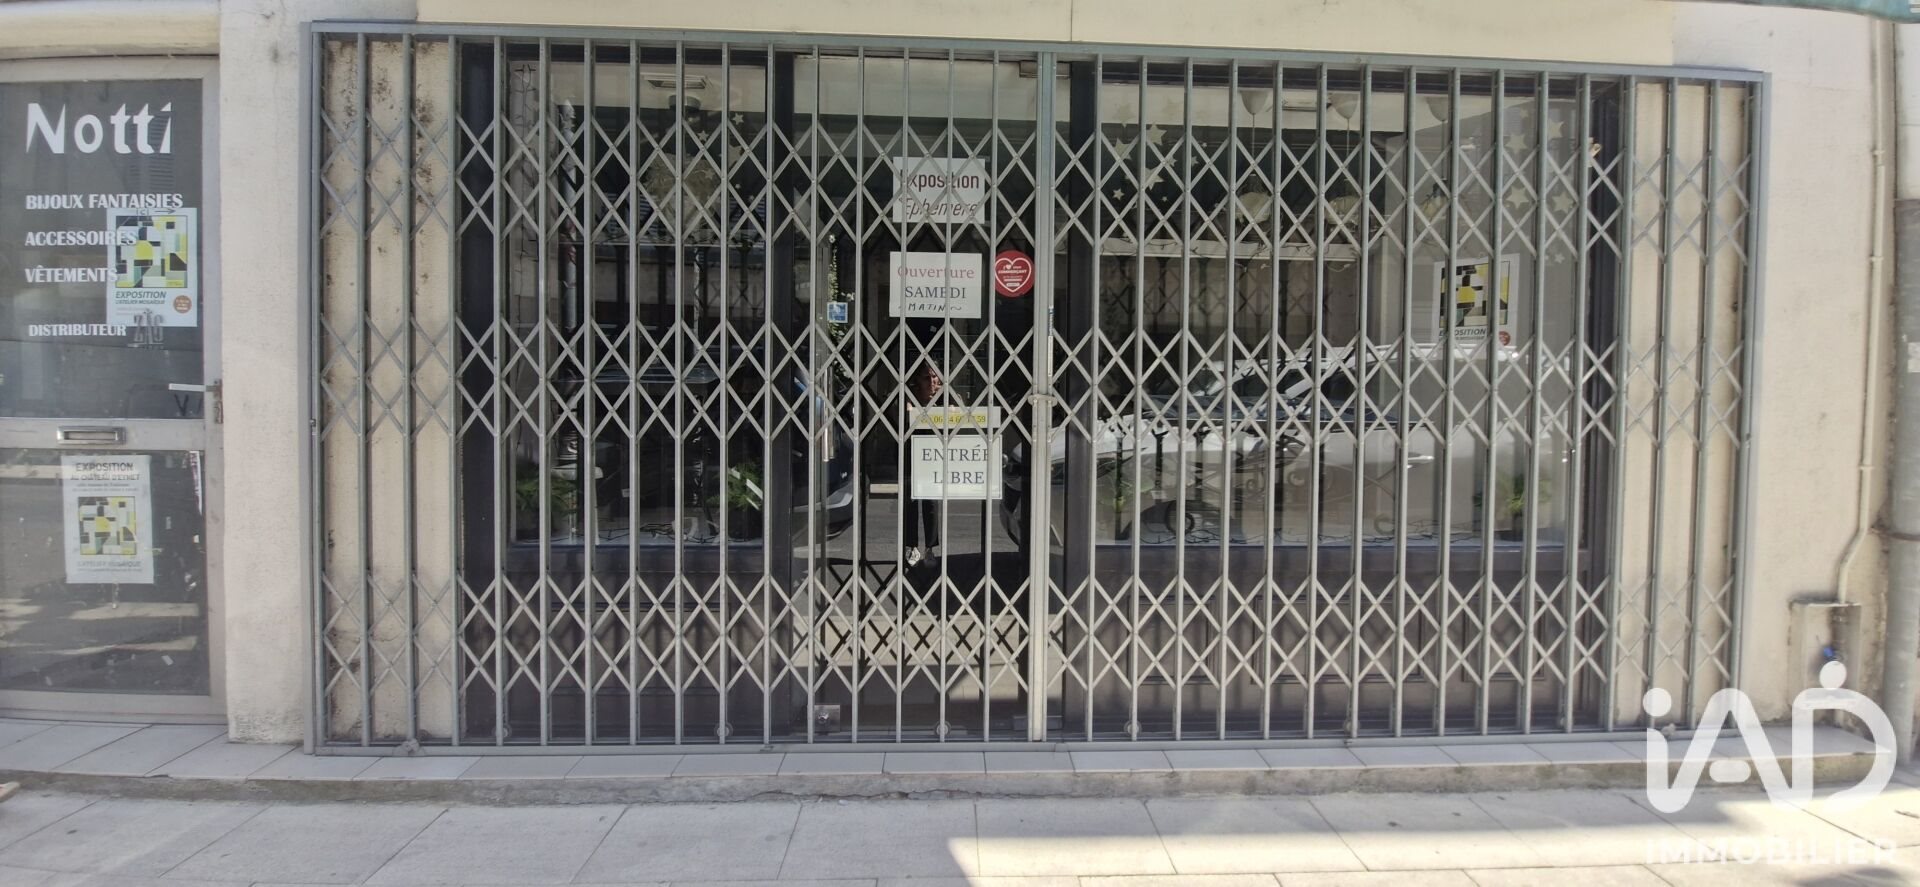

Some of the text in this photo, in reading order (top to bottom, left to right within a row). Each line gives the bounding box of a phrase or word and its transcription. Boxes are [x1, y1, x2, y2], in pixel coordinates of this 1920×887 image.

[25, 101, 172, 154] Notti
[25, 193, 183, 209] BIJOUX FANTAISIES
[25, 230, 137, 246] ACCESSOIRES
[25, 265, 117, 283] VÊTEMENTS
[115, 291, 167, 299] EXPOSITION
[28, 323, 127, 338] DISTRIBUTEUR
[76, 462, 134, 471] EXPOSITION
